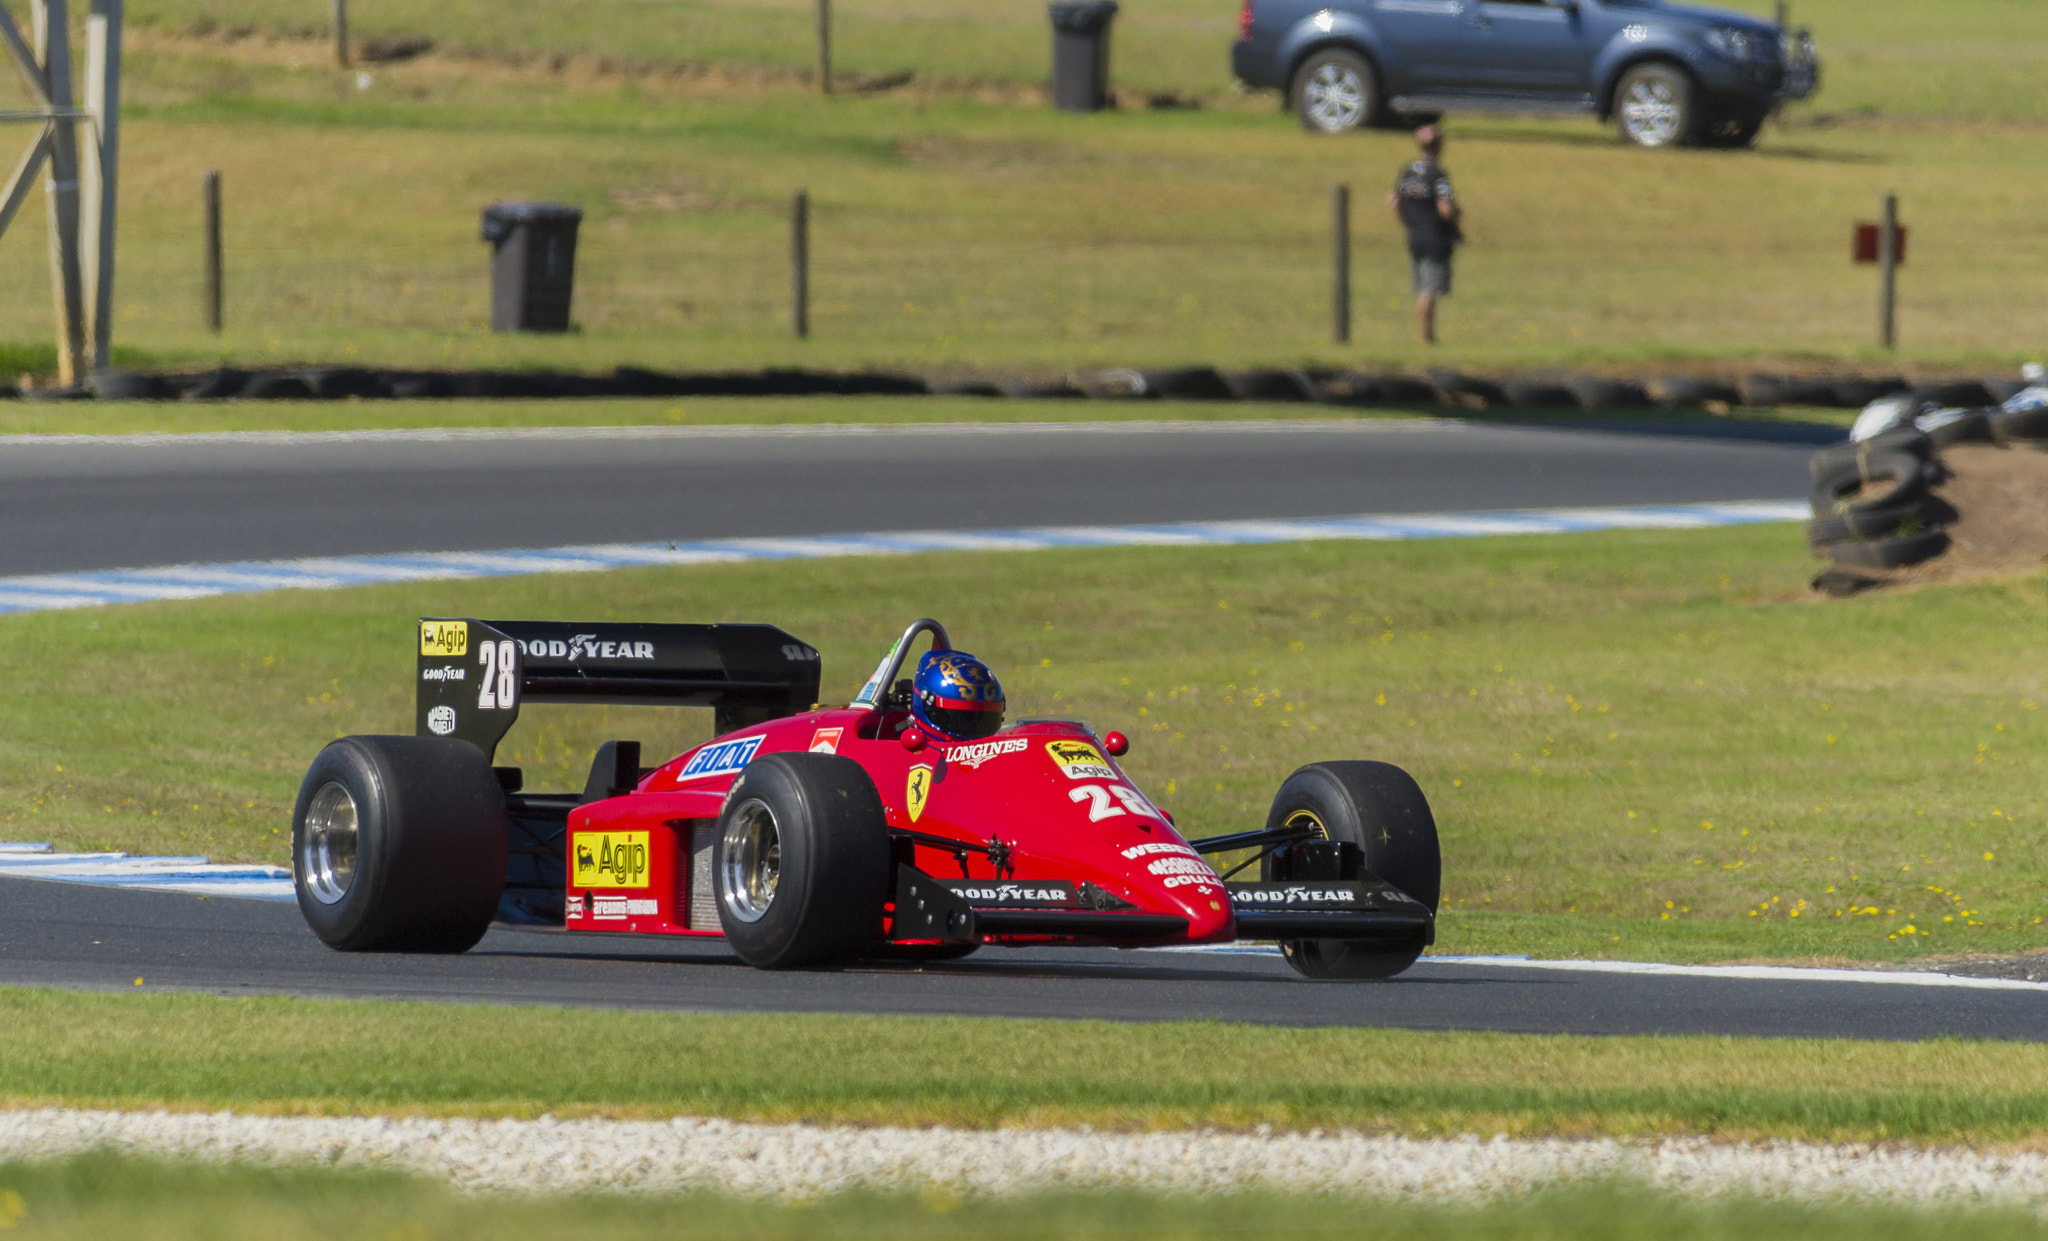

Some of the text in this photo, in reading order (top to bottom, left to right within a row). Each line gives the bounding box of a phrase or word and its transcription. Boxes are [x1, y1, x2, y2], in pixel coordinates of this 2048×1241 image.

[436, 624, 466, 653] Agip
[516, 638, 567, 657] OD
[478, 640, 516, 709] 28
[687, 742, 758, 774] FIAT
[945, 738, 1029, 762] LONGINES
[1071, 763, 1113, 777] Agip
[1068, 784, 1161, 823] 28
[598, 834, 646, 885] Agip
